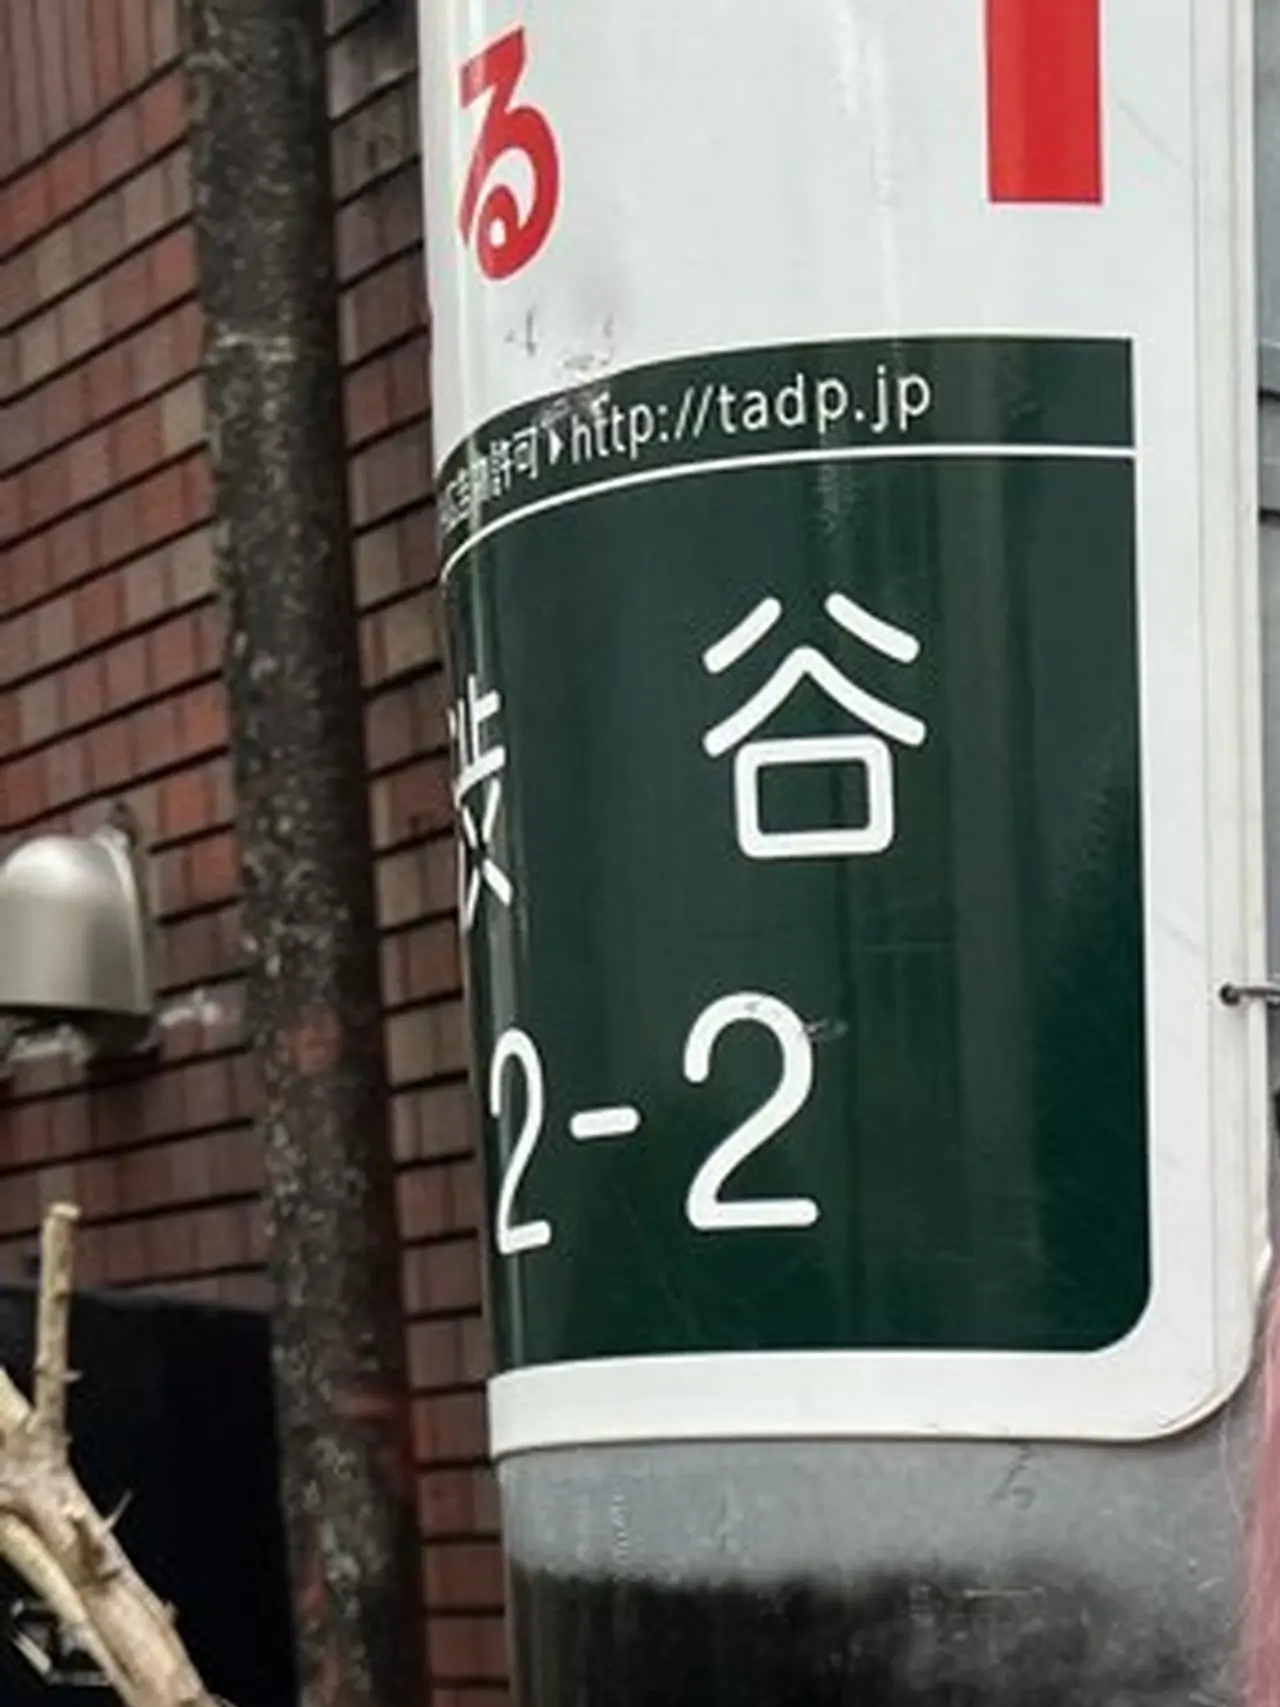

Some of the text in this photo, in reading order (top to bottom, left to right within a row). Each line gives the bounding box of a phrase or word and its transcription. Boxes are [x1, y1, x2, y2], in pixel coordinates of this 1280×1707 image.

[460, 25, 560, 281] る
[570, 364, 931, 465] http://tadp.jp
[490, 992, 819, 1255] 2-2
